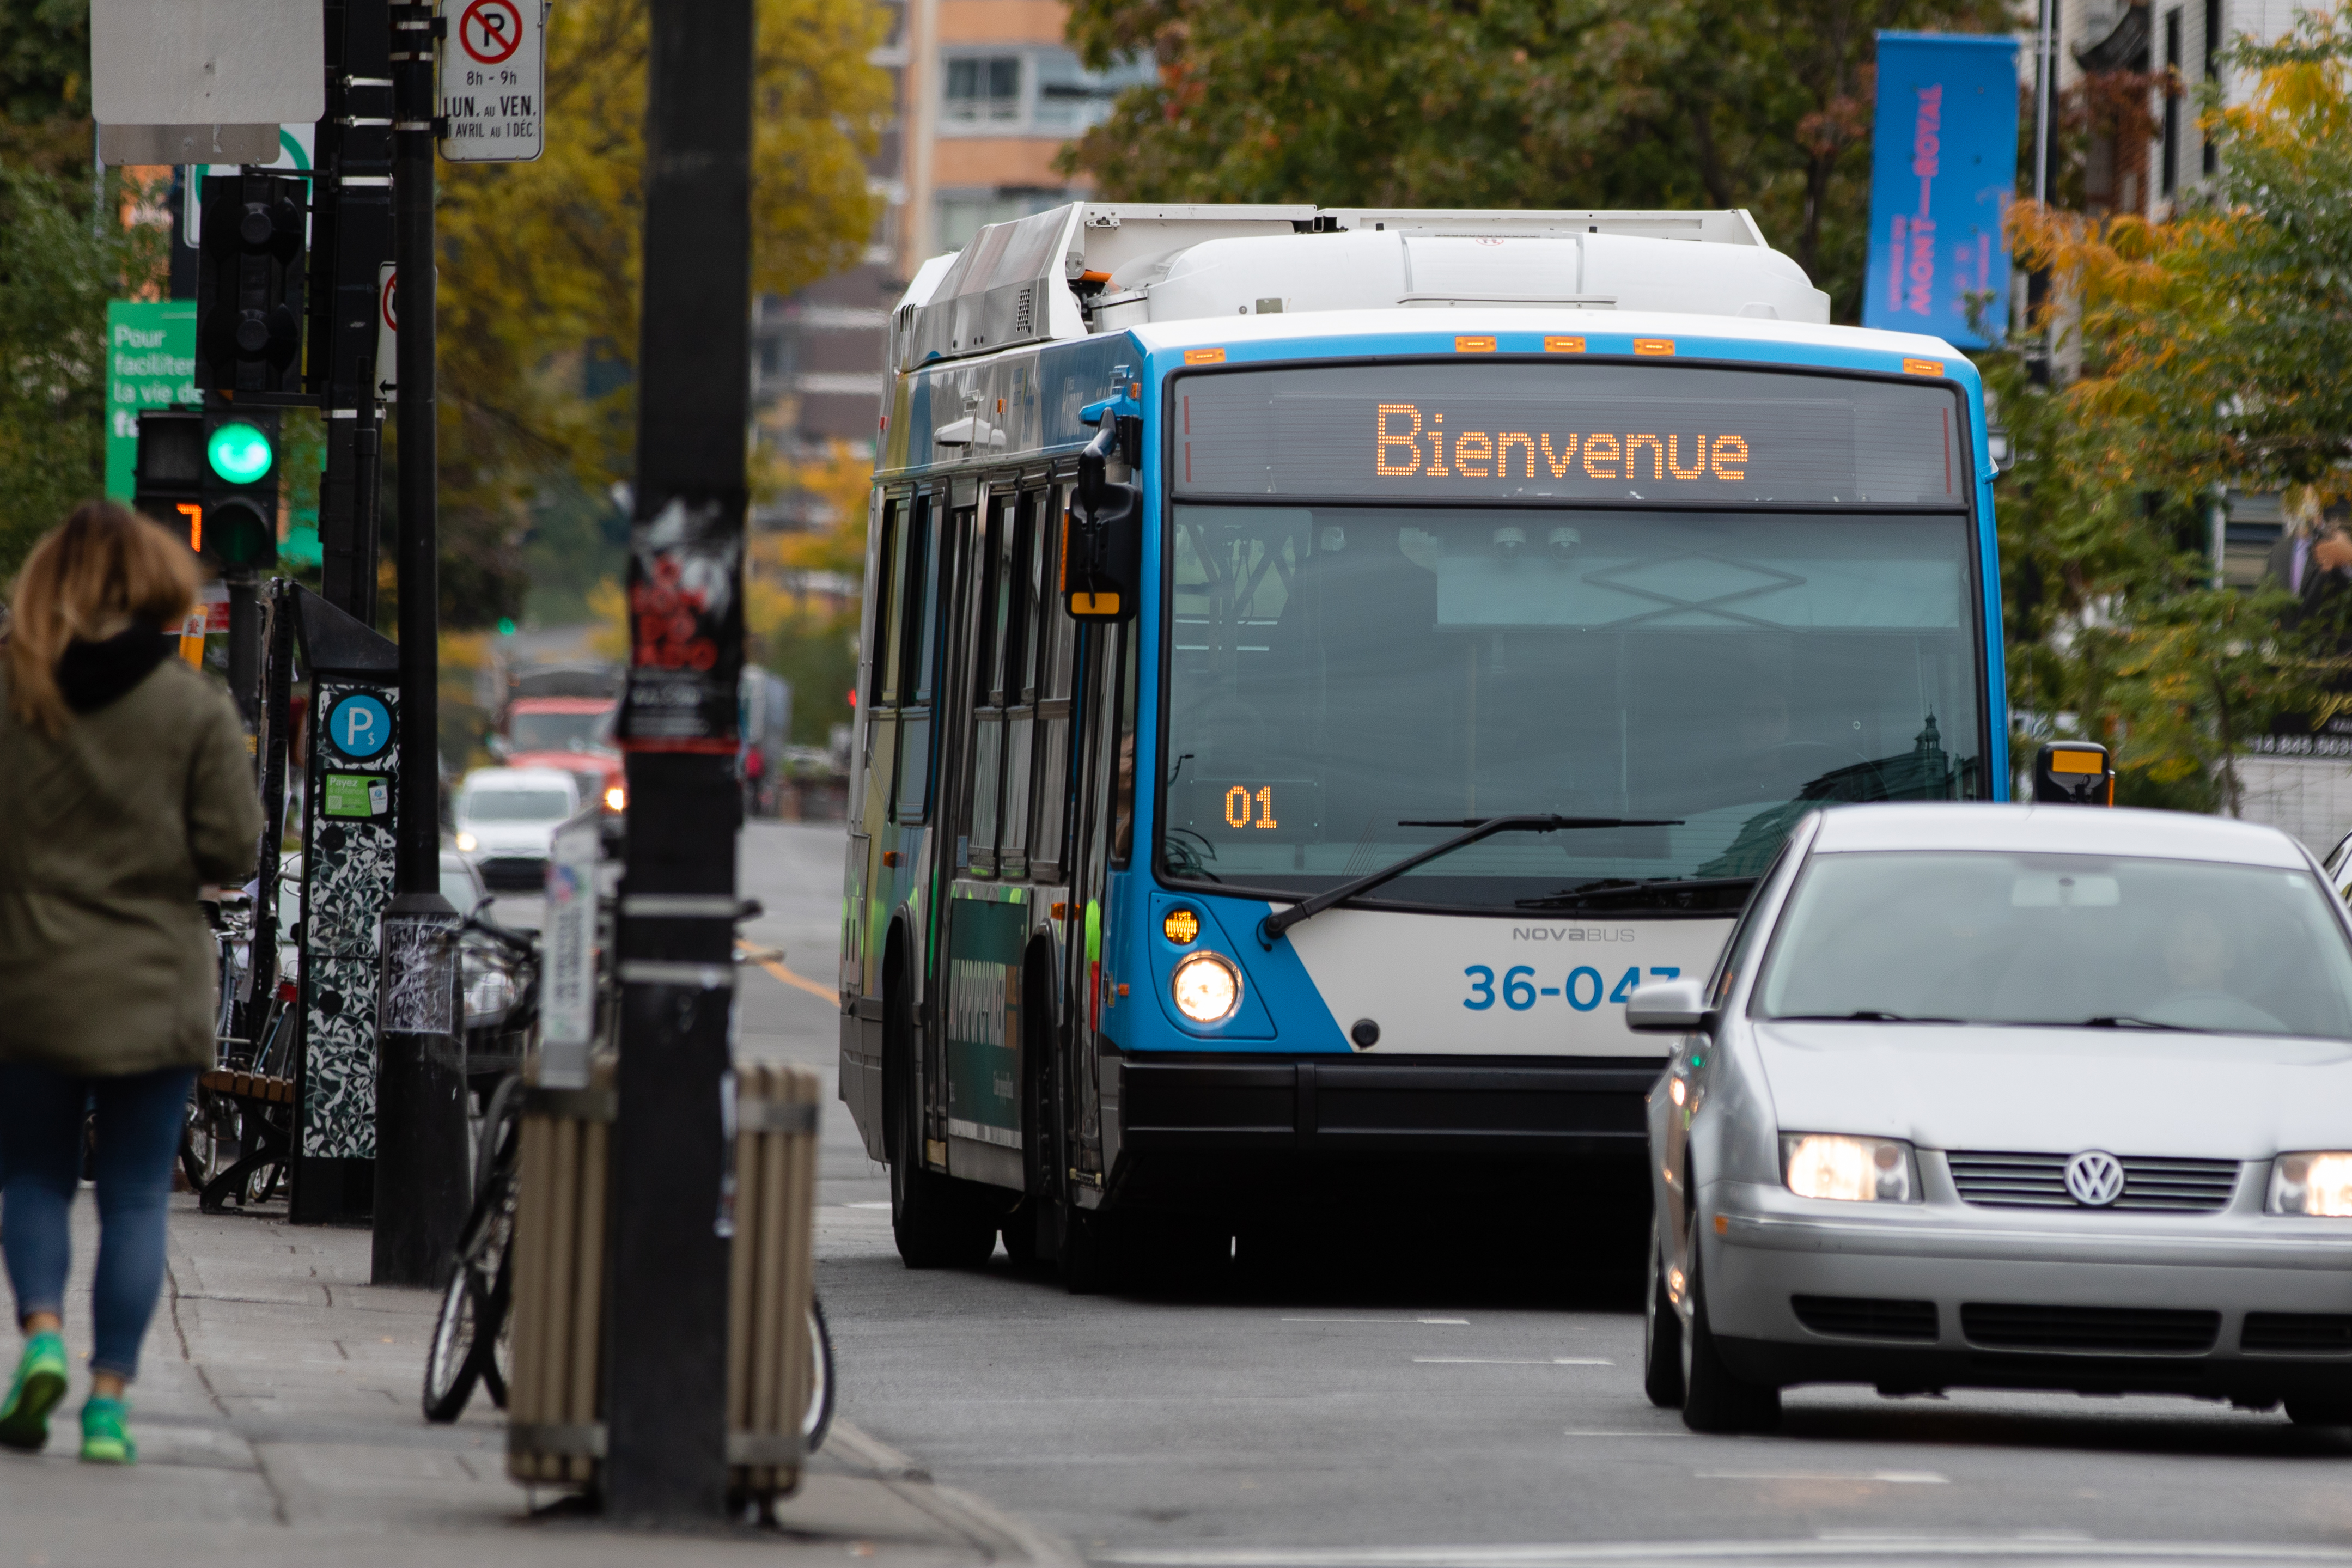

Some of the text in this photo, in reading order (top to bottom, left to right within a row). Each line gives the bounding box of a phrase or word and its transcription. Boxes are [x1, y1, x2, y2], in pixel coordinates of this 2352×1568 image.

[466, 71, 483, 86] 8h
[500, 70, 516, 86] 9h
[444, 95, 537, 118] LUN. AU VEN.
[455, 123, 484, 138] AVRIL
[491, 127, 501, 138] AU
[513, 119, 536, 137] DÉC.
[114, 324, 167, 349] Pour
[114, 352, 196, 377] faciliter
[113, 380, 137, 404] la
[139, 380, 174, 404] vie
[1377, 404, 1748, 480] Bienvenue
[176, 503, 202, 552] 7
[330, 777, 358, 790] Payez
[1226, 786, 1277, 828] 01
